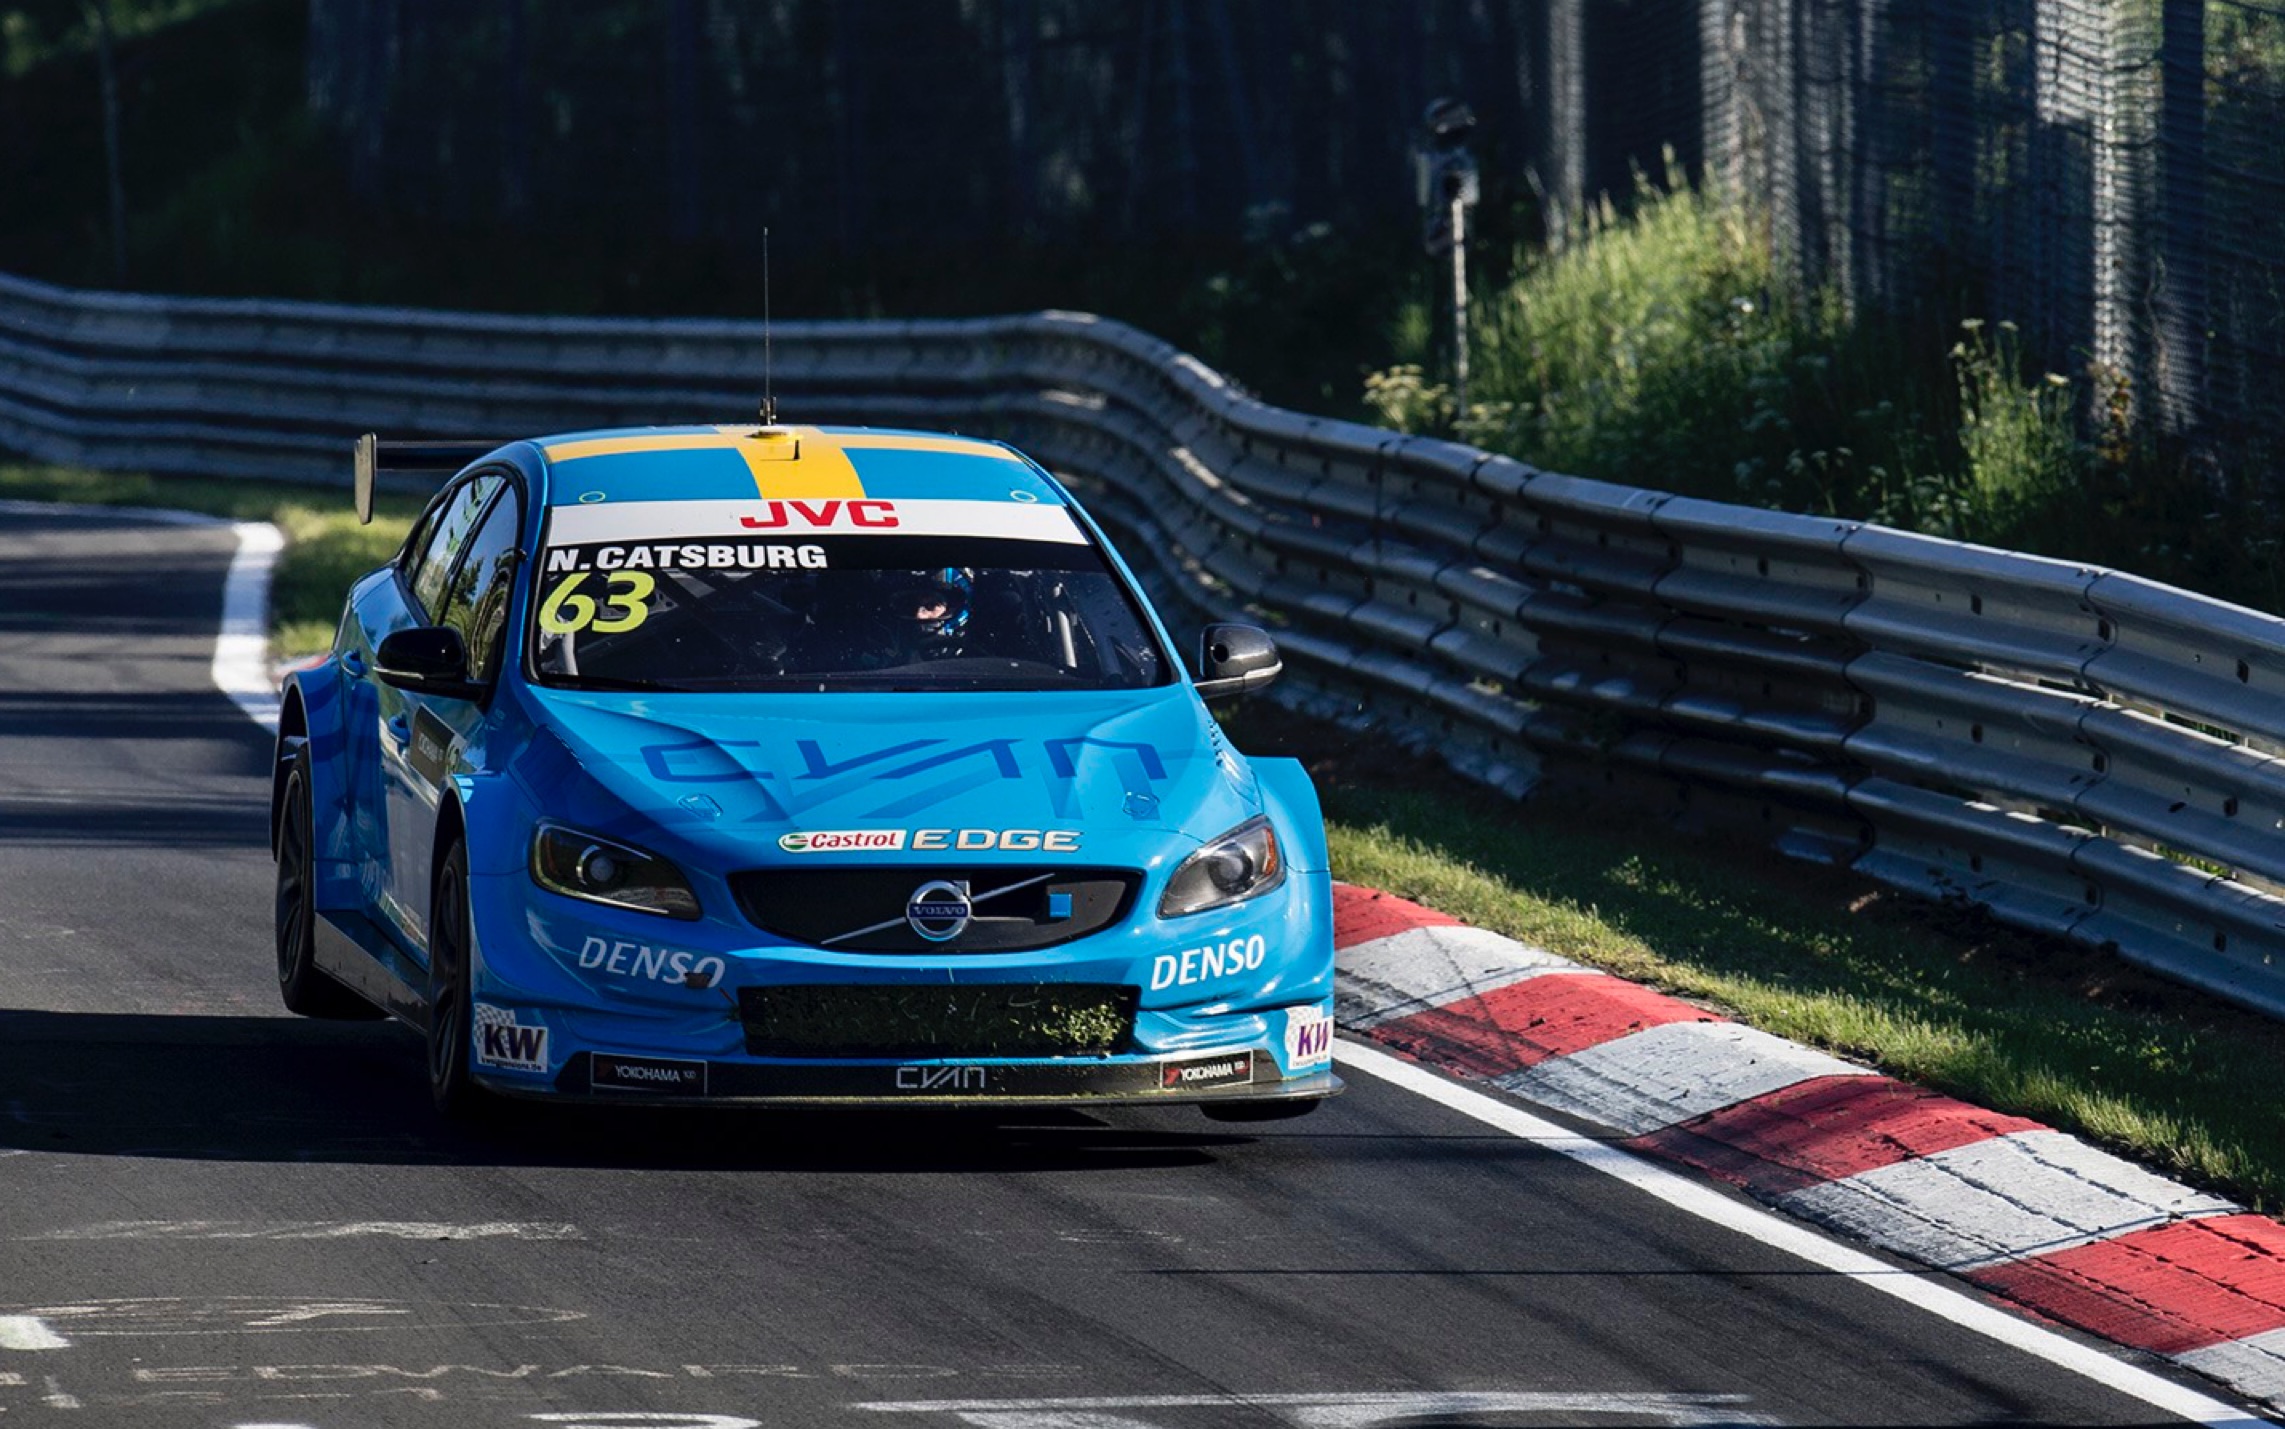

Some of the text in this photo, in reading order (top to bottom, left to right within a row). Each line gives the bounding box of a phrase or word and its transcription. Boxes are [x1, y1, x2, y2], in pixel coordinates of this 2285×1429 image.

[740, 500, 899, 529] JVC
[547, 545, 828, 572] N.CATSBURG
[538, 571, 656, 633] 63
[810, 828, 1084, 852] Castrol EDGE
[914, 905, 966, 915] VOLVO
[1151, 934, 1266, 991] DENSO
[484, 1023, 547, 1062] KW
[1297, 1021, 1329, 1057] KW
[615, 1064, 681, 1083] YOKOHAMA
[1180, 1062, 1234, 1081] YOKOHAMA
